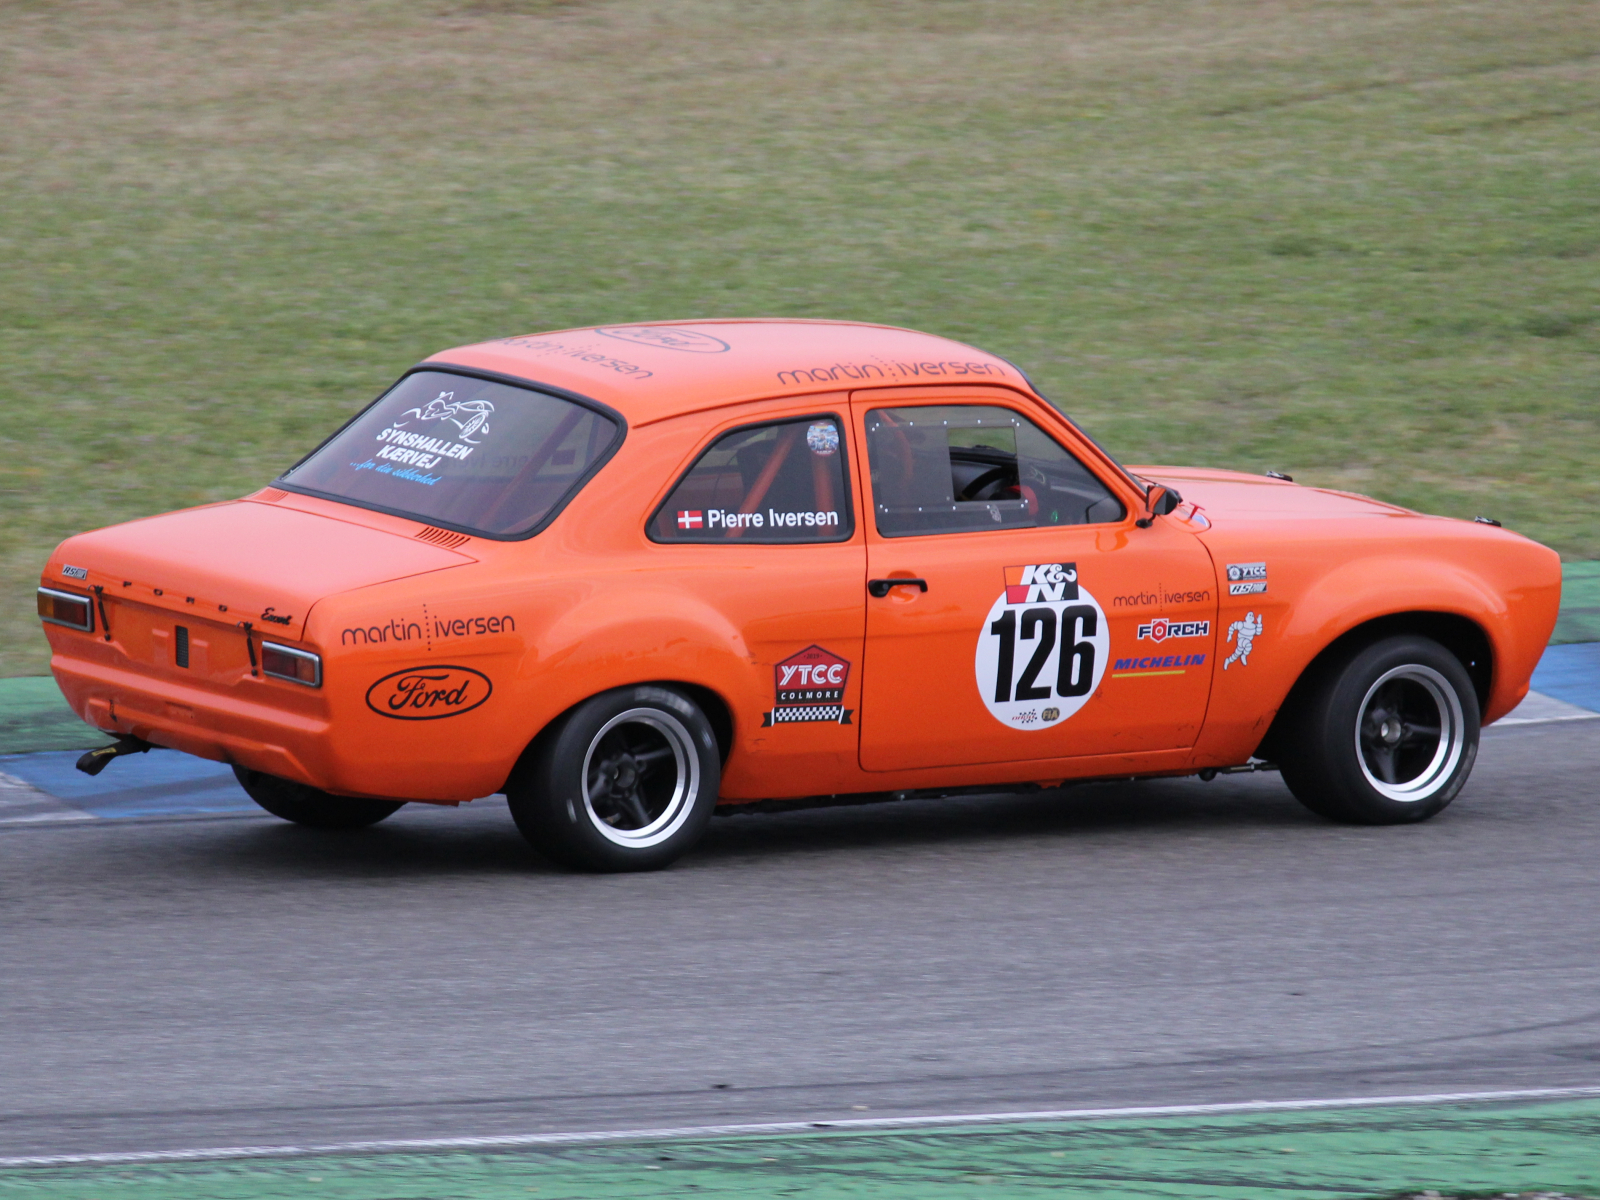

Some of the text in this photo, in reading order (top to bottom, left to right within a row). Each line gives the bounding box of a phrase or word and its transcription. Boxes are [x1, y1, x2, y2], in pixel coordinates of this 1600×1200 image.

[777, 360, 1006, 385] martin iversen
[376, 428, 474, 460] SYNSHALLEN
[376, 445, 442, 469] KÆRVEJ
[707, 509, 839, 528] Pierre Iversen
[1113, 590, 1210, 607] martin iversen
[342, 615, 515, 646] martin iversen
[990, 604, 1098, 703] 126
[1113, 654, 1206, 670] MICHELIN
[780, 663, 844, 686] YTCC
[388, 674, 470, 711] Ford
[781, 690, 839, 700] COLMORE
[1042, 709, 1059, 720] FIA
